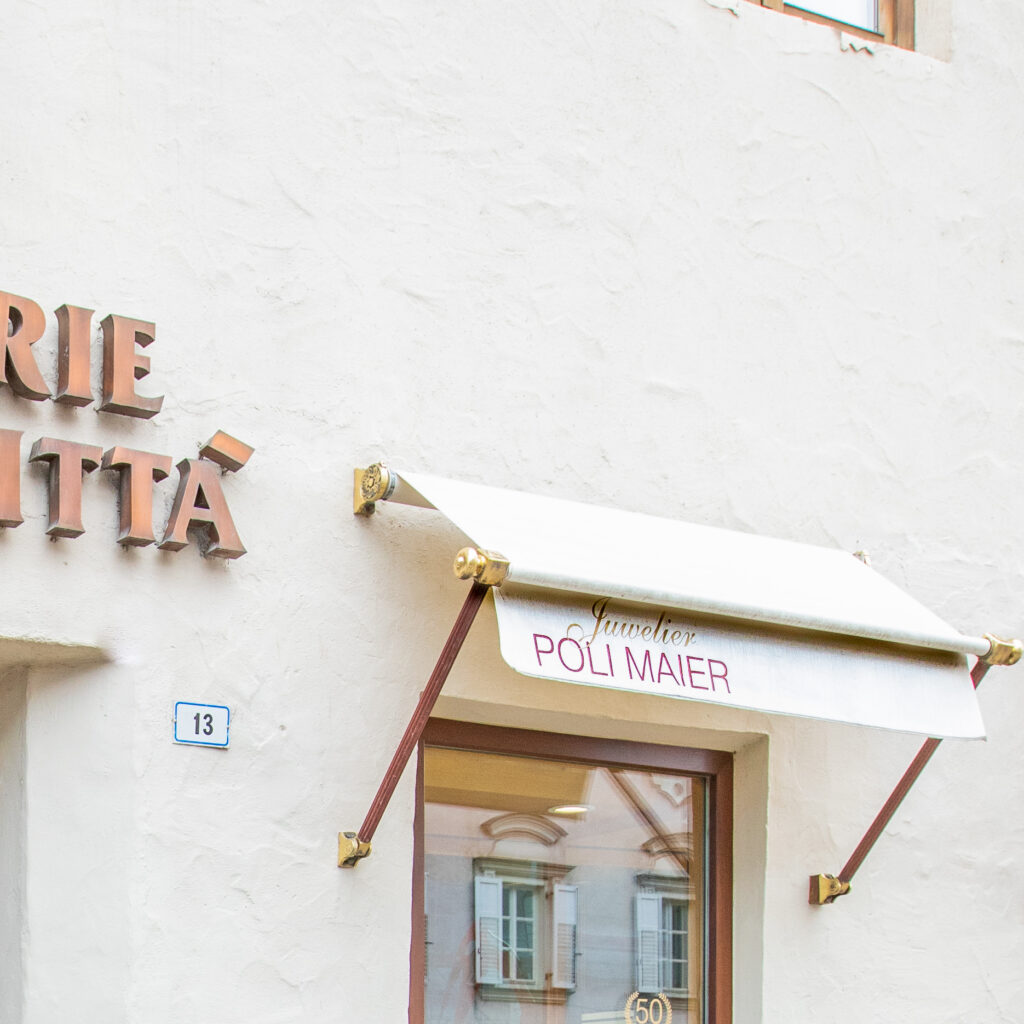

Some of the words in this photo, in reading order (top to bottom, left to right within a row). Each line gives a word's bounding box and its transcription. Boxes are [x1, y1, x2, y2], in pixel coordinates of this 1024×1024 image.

[566, 597, 697, 650] Juwelier
[532, 633, 615, 677] POLI
[624, 646, 731, 694] MAIER
[193, 712, 214, 736] 13
[636, 998, 663, 1024] 50
